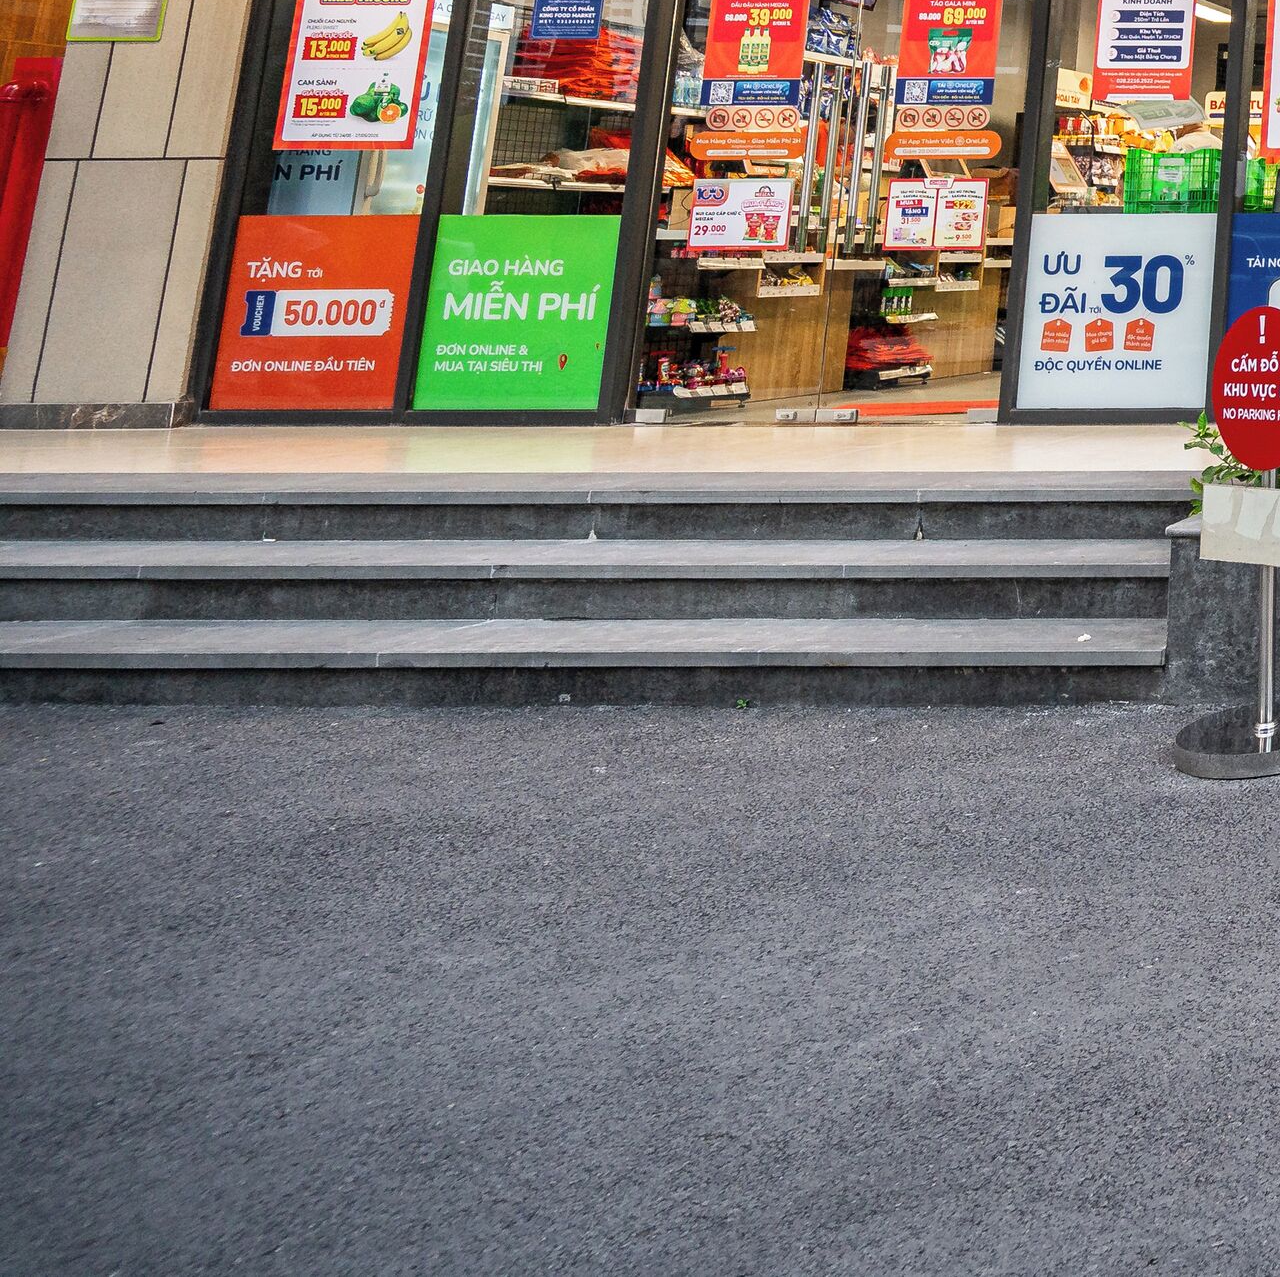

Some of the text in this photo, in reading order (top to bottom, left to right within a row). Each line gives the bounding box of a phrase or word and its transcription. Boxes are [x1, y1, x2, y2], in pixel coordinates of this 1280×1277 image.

[748, 9, 793, 26] 39.000
[943, 8, 987, 25] 69.000
[694, 225, 727, 236] 29.000
[247, 256, 323, 283] TẶNG TỚI
[448, 255, 564, 277] GIAO HÀNG
[1043, 251, 1082, 275] ƯU
[1246, 254, 1265, 269] TẢI
[443, 281, 602, 321] MIỄN PHÍ
[1039, 287, 1087, 314] ĐÃI
[251, 295, 266, 332] VOUCHER
[283, 299, 386, 327] 50.000đ
[436, 343, 528, 356] ĐƠN ONLINE &
[231, 353, 376, 372] ĐƠN ONLINE ĐẦU TIÊN
[434, 357, 543, 375] MUA TẠI SIÊU THỊ
[1034, 356, 1162, 374] ĐỘC QUYỀN ONLINE
[1231, 352, 1258, 373] CẤM
[1260, 351, 1279, 373] ĐỖ
[1223, 382, 1249, 397] KHU
[1250, 381, 1277, 402] VỰC
[1222, 407, 1236, 420] NO
[1237, 408, 1276, 421] PARKING
